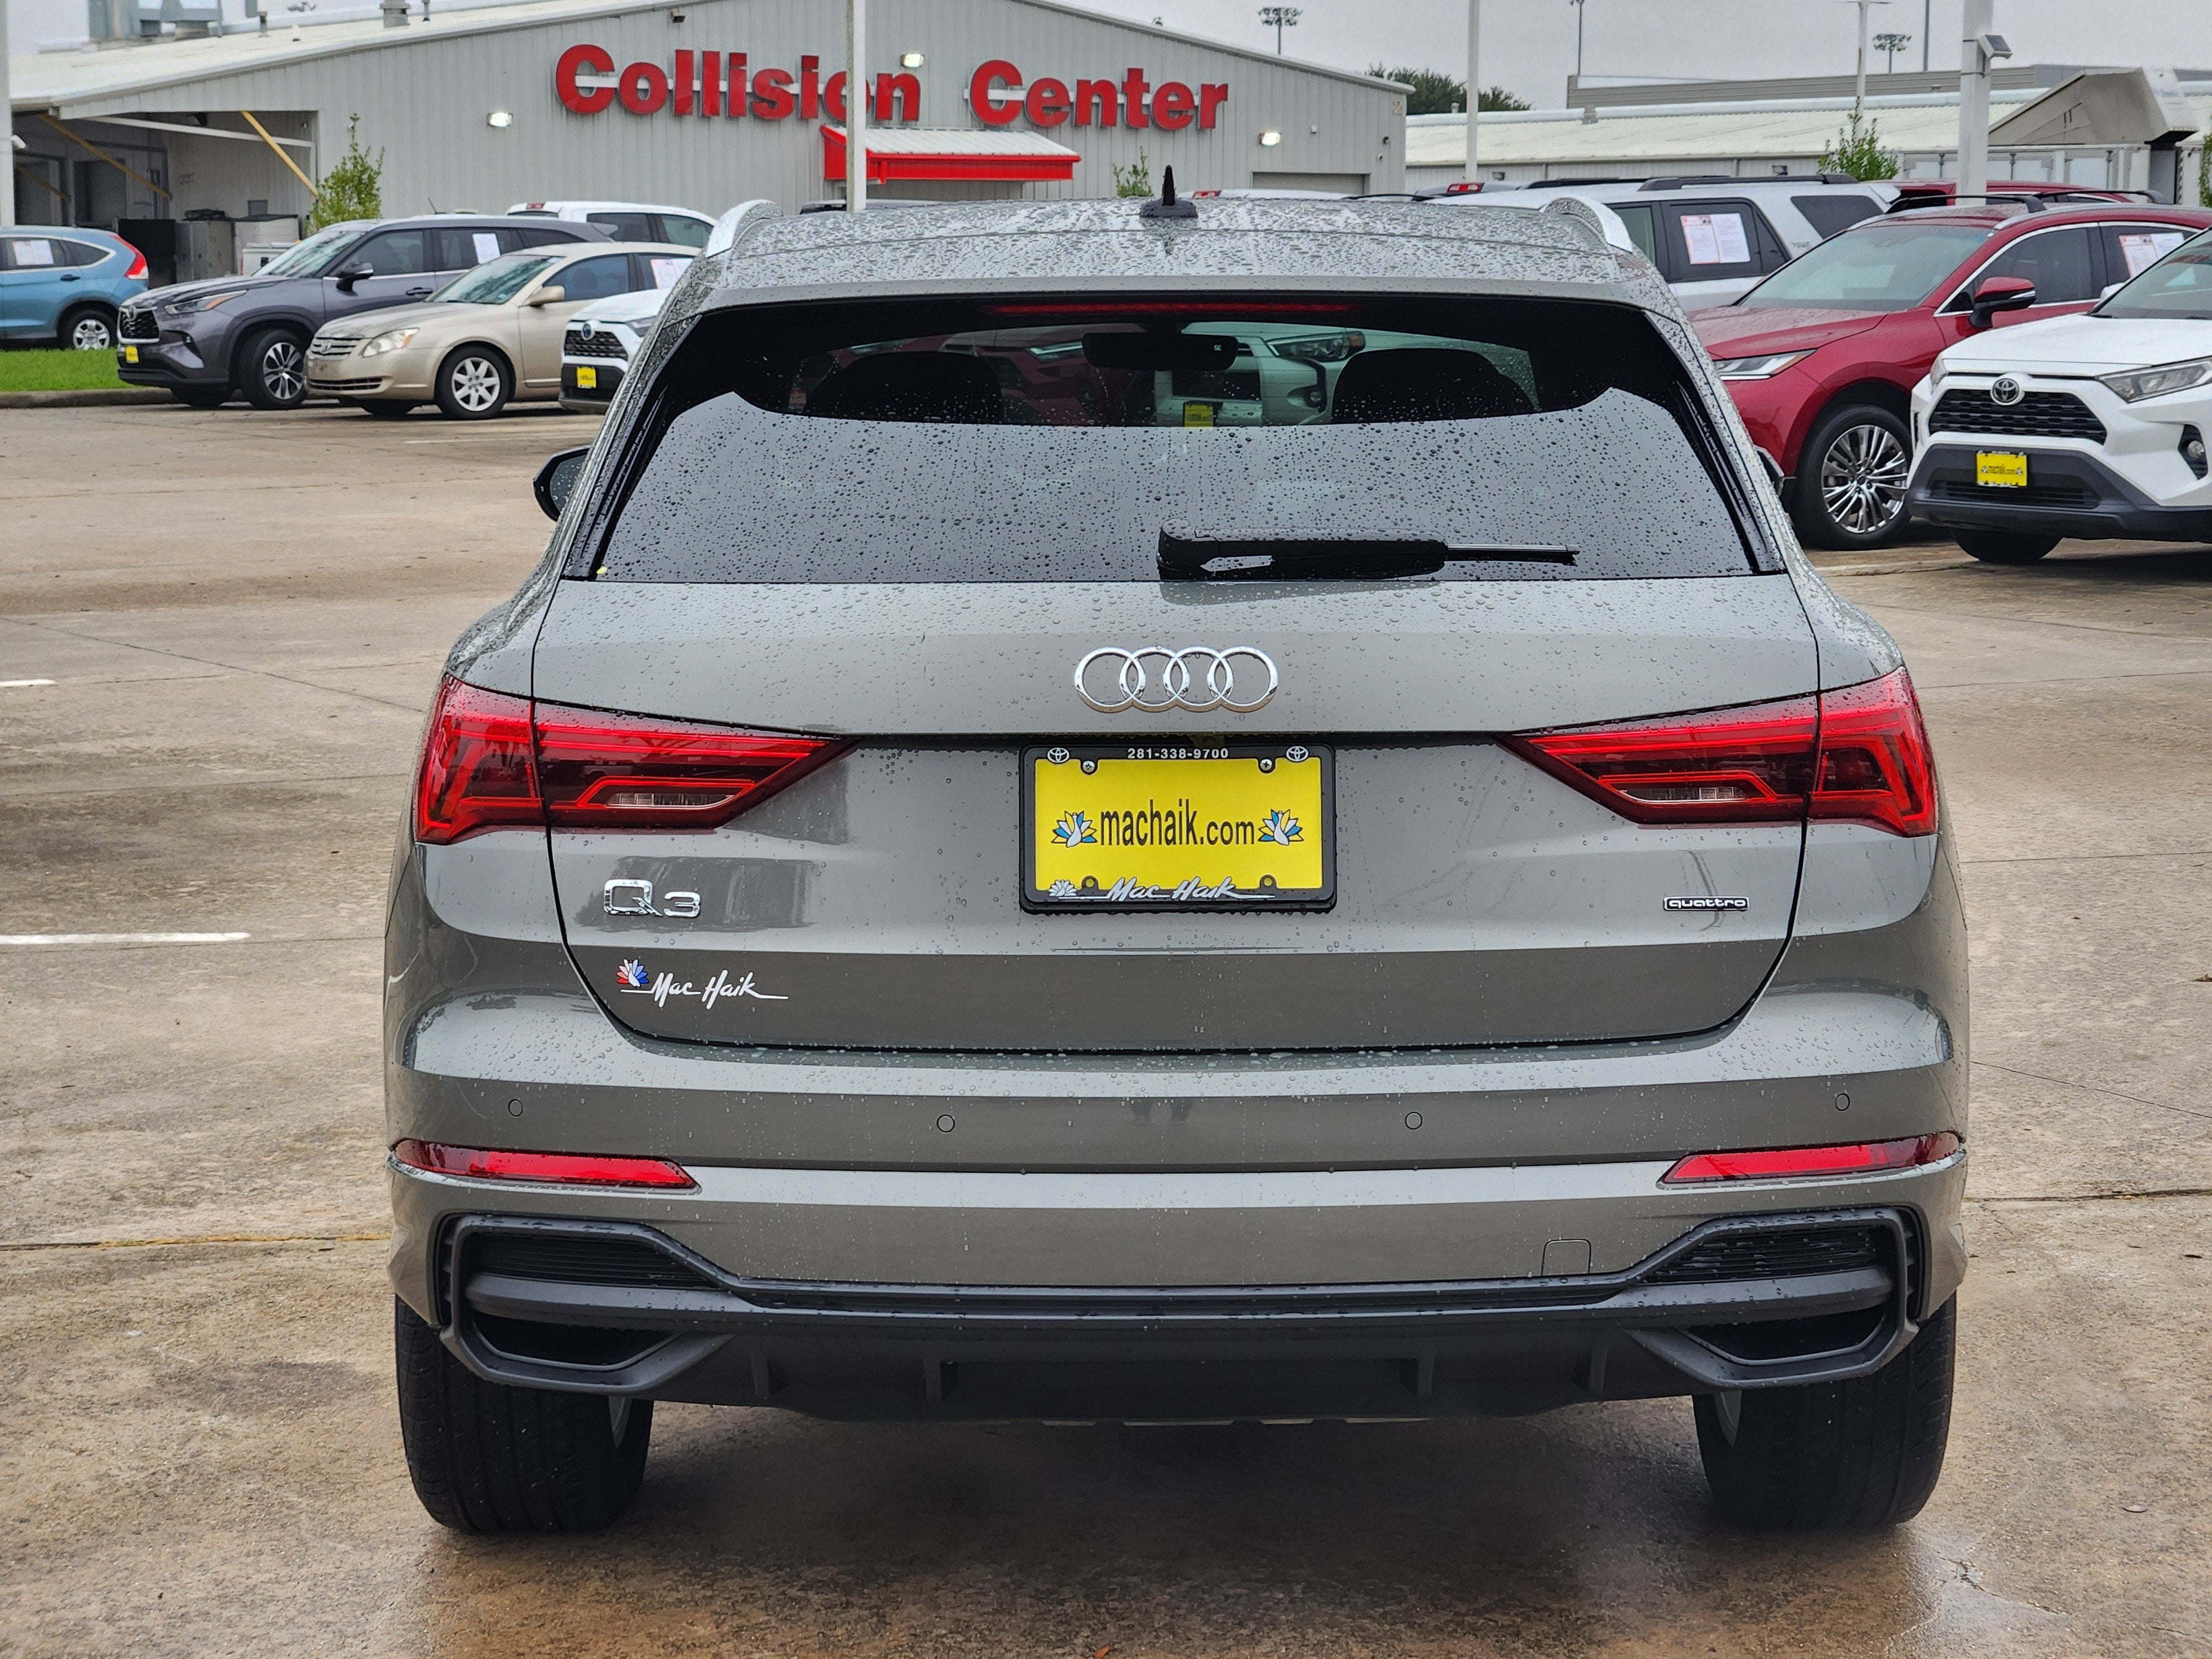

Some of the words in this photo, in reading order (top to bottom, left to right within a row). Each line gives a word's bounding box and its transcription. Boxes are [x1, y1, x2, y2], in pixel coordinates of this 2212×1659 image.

[555, 44, 921, 122] Collision
[969, 59, 1229, 131] Center
[1127, 748, 1229, 759] 281-338-9700
[1100, 798, 1255, 846] machaik.com
[604, 879, 701, 918] Q3
[1058, 877, 1172, 902] Mac
[1170, 875, 1276, 902] Haik
[1668, 898, 1746, 909] quattro
[620, 972, 702, 1008] Mac
[701, 969, 789, 1010] Haik
